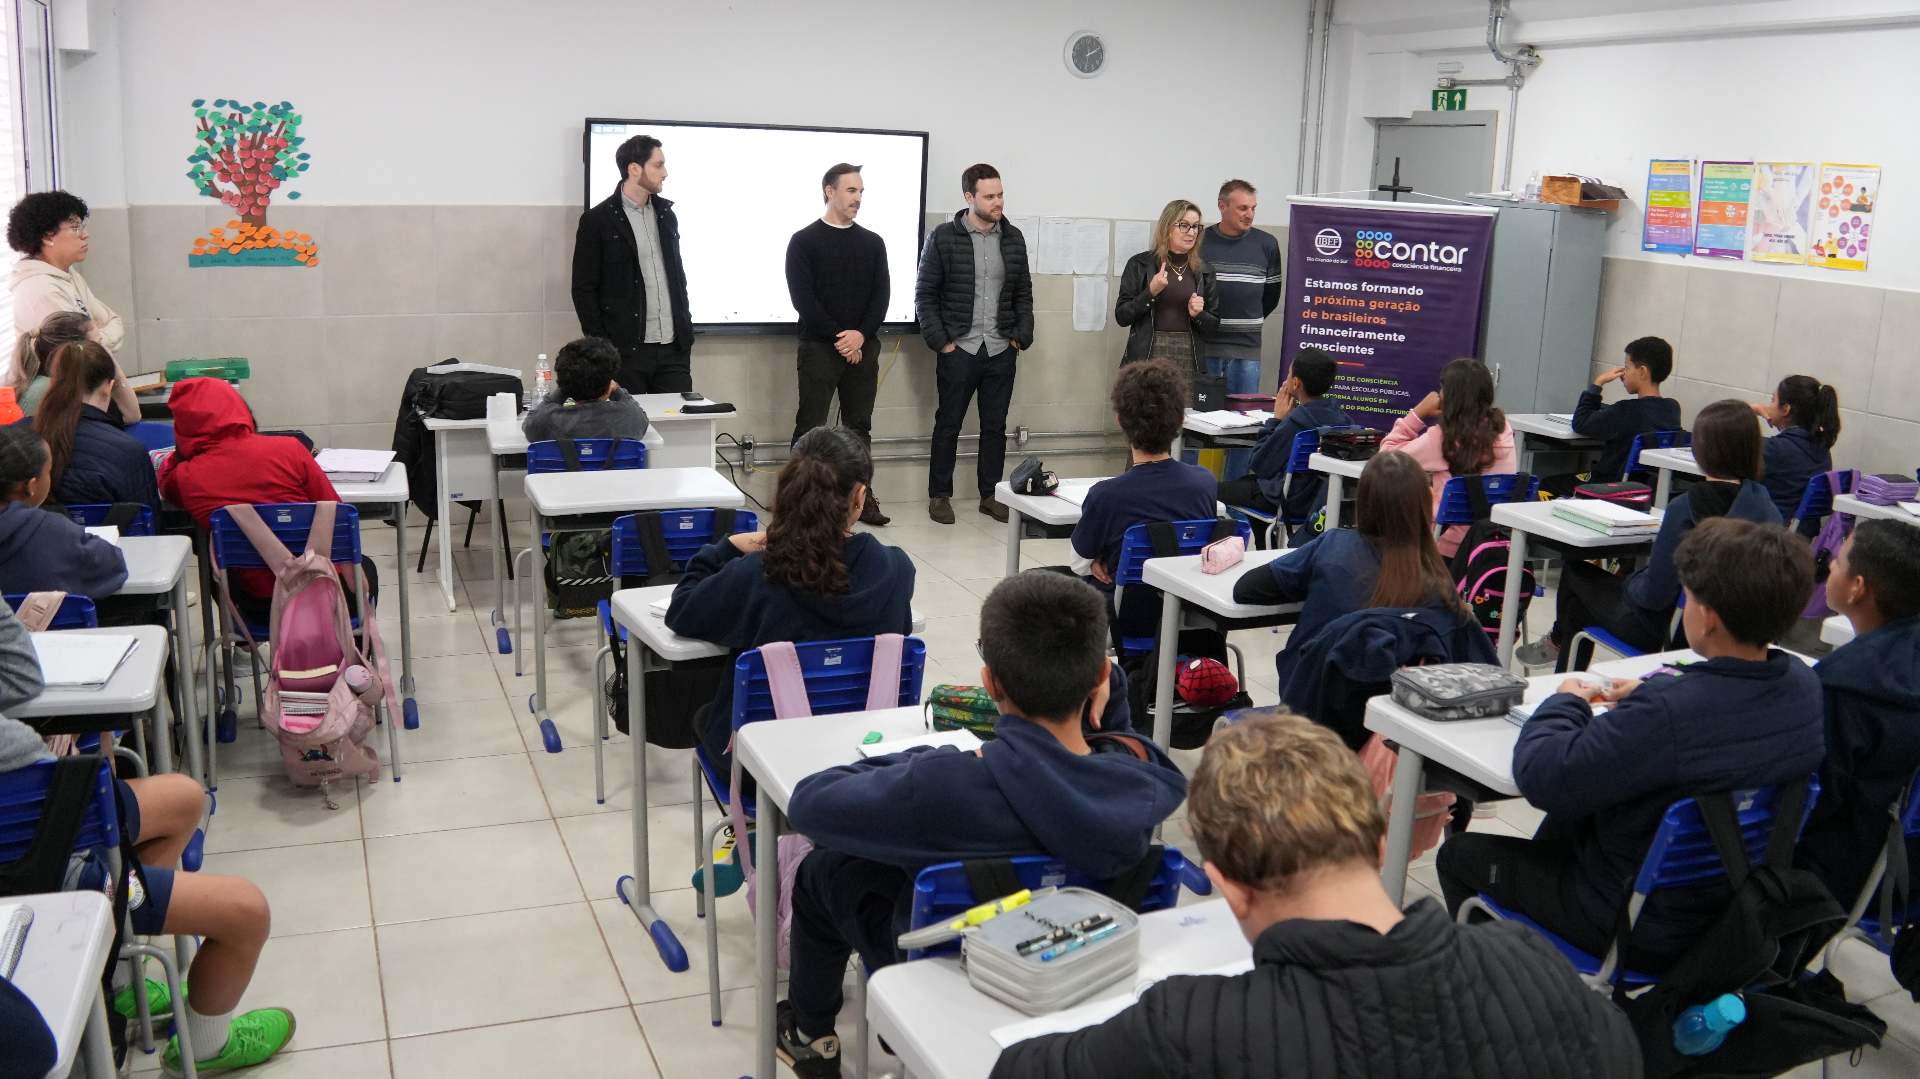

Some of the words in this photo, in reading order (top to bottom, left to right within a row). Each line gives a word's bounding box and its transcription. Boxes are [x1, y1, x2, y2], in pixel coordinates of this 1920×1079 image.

[1318, 238, 1339, 246] IBEF
[1374, 241, 1468, 264] contar
[1392, 262, 1429, 270] consciência
[1430, 264, 1462, 273] financeira
[1305, 278, 1358, 291] Estamos
[1361, 282, 1424, 296] formando
[1303, 295, 1311, 303] a
[1314, 295, 1365, 307] próxima
[1369, 300, 1421, 312] geração
[1302, 309, 1318, 319] de
[1321, 310, 1387, 325] brasileiros
[1300, 324, 1406, 342] financeiramente
[1299, 341, 1375, 355] conscientes
[1356, 377, 1398, 385] CONSCIÊNCIA
[1351, 386, 1379, 394] ESCOLAS
[1352, 395, 1378, 403] ALUNOS
[1356, 405, 1385, 413] PRÓPRIO
